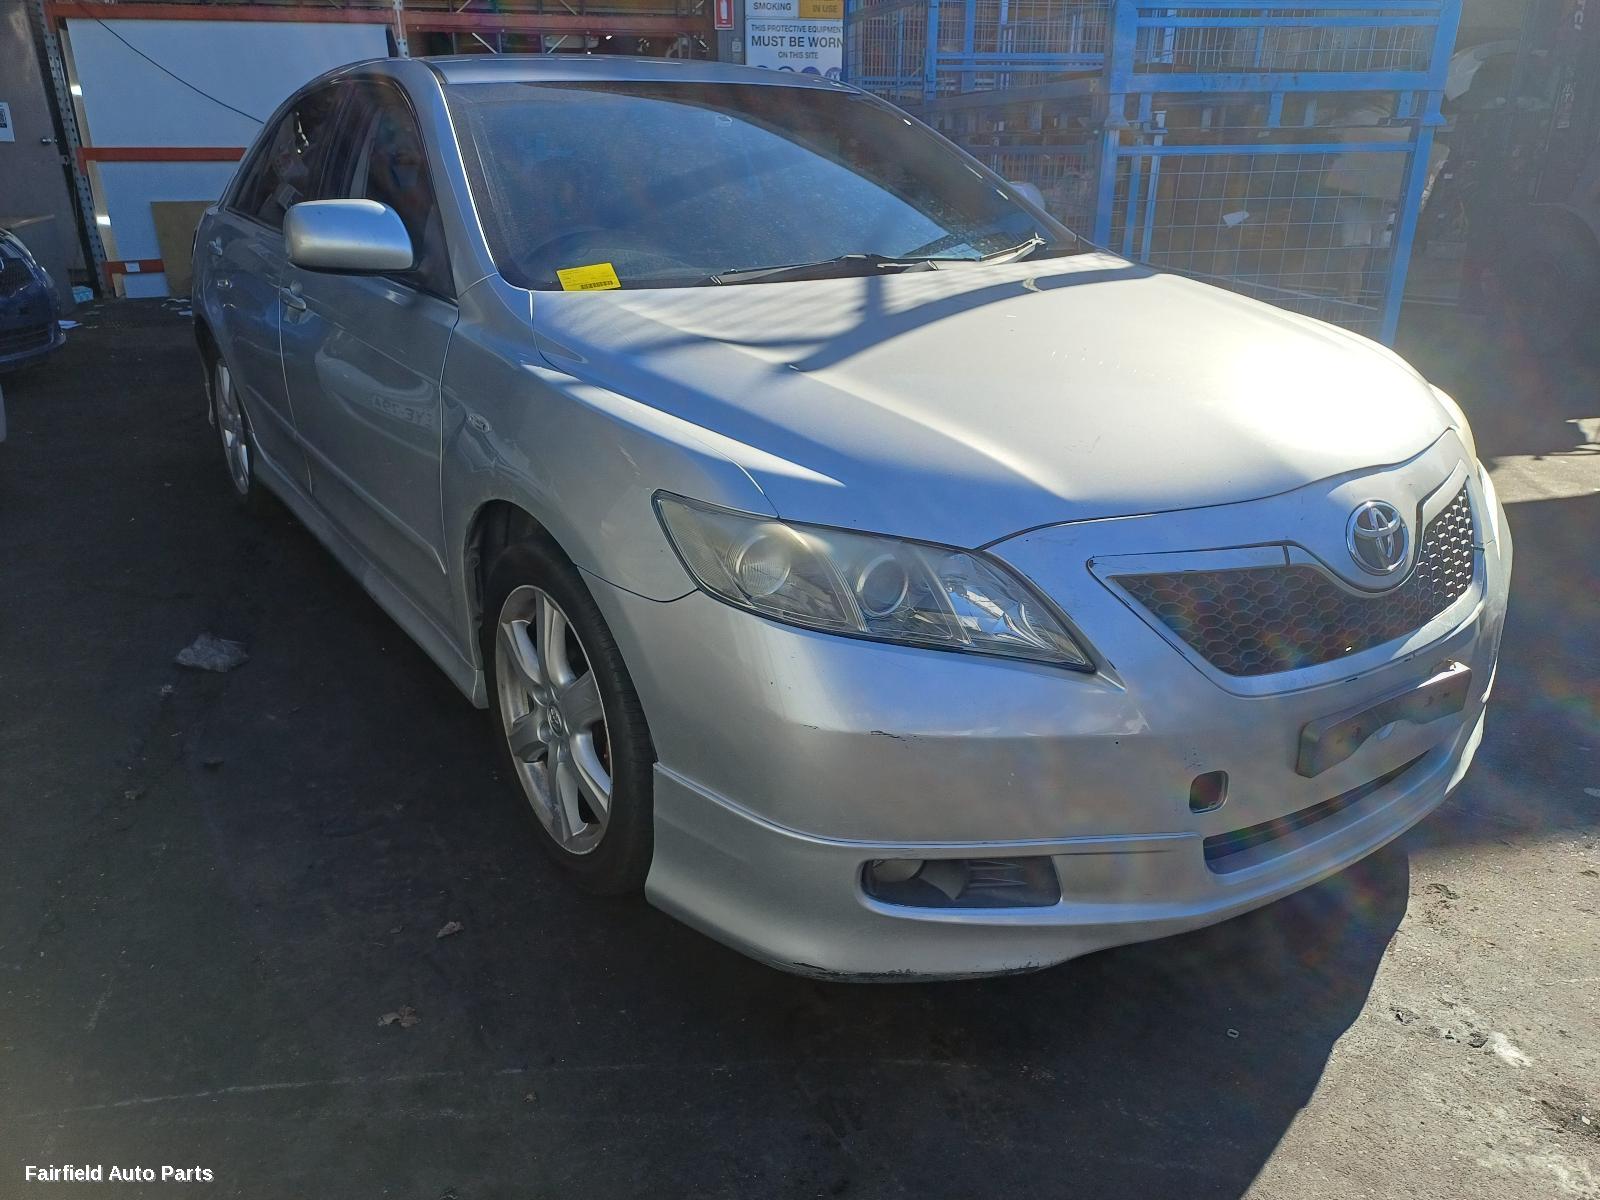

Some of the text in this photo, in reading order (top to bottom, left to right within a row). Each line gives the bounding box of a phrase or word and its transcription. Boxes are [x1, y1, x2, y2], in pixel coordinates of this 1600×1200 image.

[753, 2, 792, 11] SMOKING
[812, 4, 838, 13] IN USE
[751, 24, 766, 32] THIS
[767, 24, 806, 33] PROTECTIVE
[751, 35, 844, 49] MUST BE WORN
[777, 51, 819, 60] ON THIS SITE
